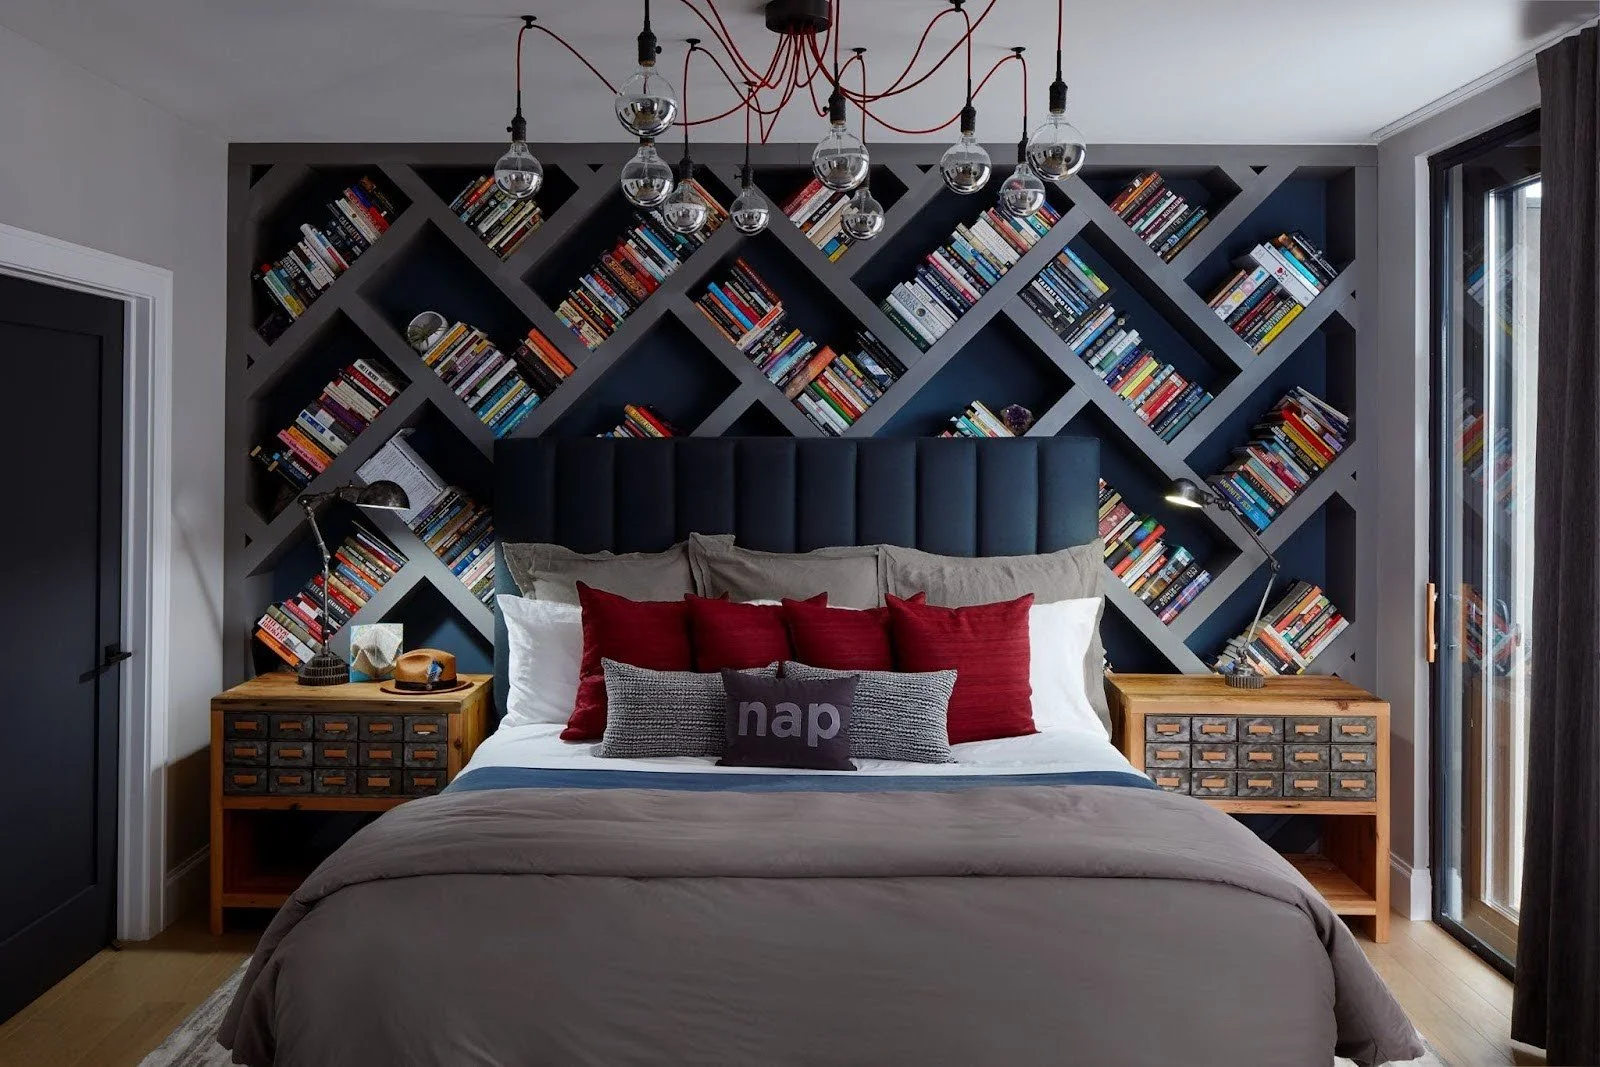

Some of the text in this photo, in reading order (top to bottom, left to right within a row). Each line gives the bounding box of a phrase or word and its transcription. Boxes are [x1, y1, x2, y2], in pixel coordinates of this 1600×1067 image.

[1036, 277, 1074, 315] TAIPEI TAO LIN
[1218, 478, 1254, 513] INFINITE JEST
[260, 619, 284, 641] BROKER
[264, 616, 277, 627] THE
[738, 701, 841, 748] nap
